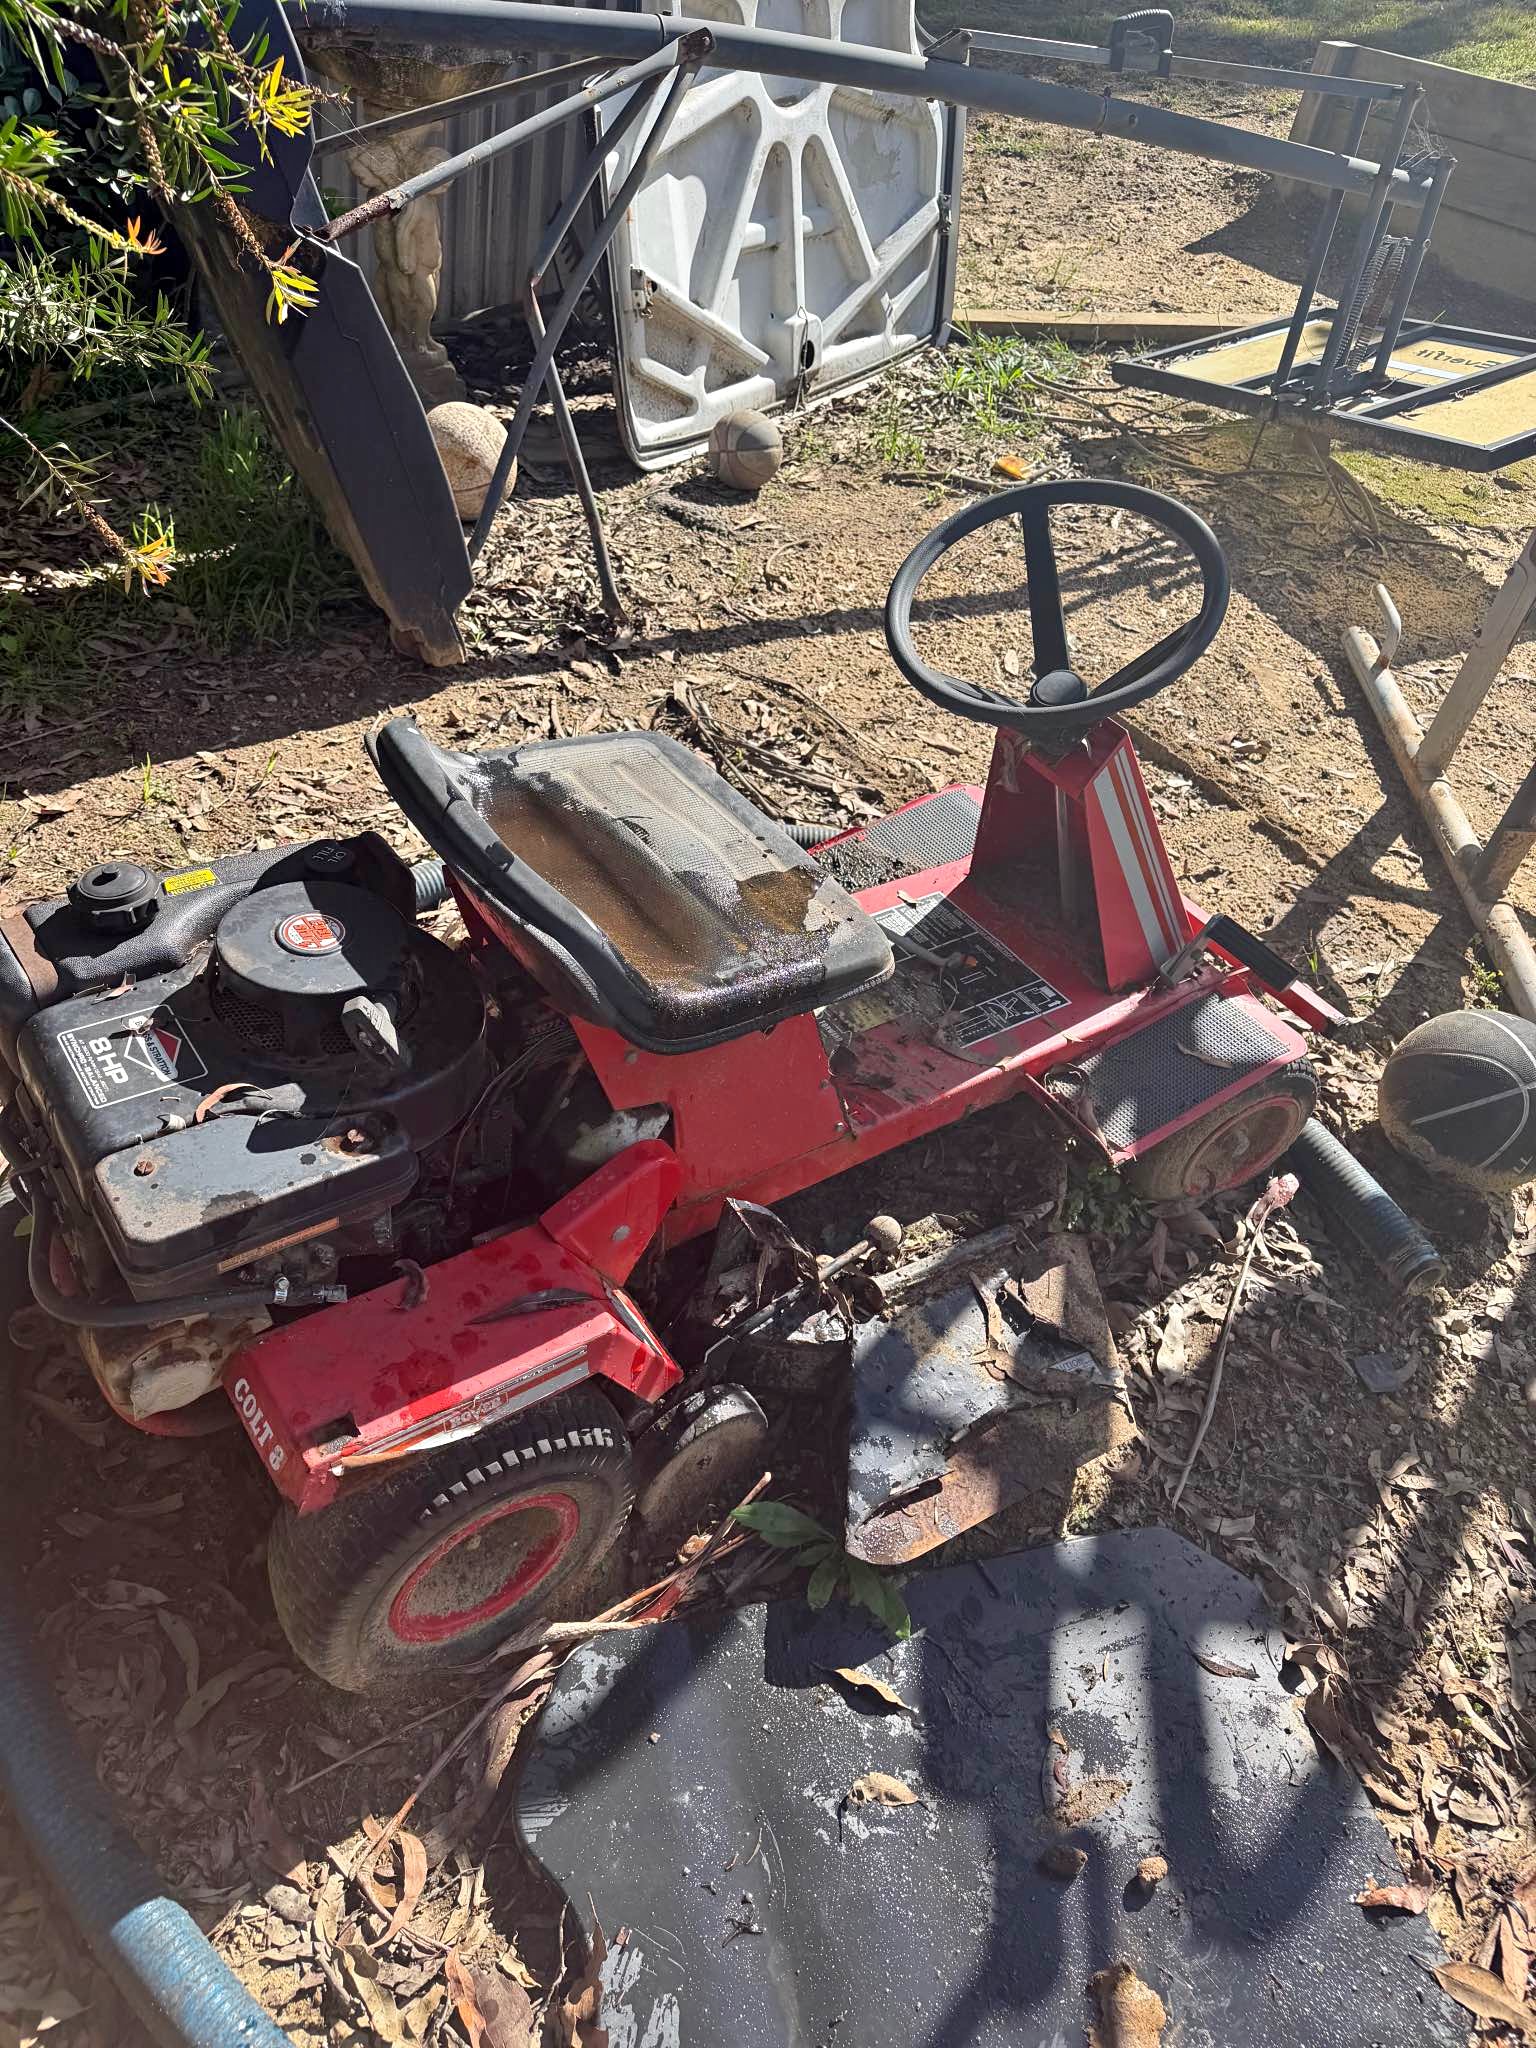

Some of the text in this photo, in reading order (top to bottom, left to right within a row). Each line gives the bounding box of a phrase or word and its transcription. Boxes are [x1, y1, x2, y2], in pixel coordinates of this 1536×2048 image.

[171, 881, 210, 897] CAUTION
[149, 1046, 172, 1076] STRATTON
[235, 1378, 284, 1471] COLT 8
[450, 1395, 502, 1429] ROVER
